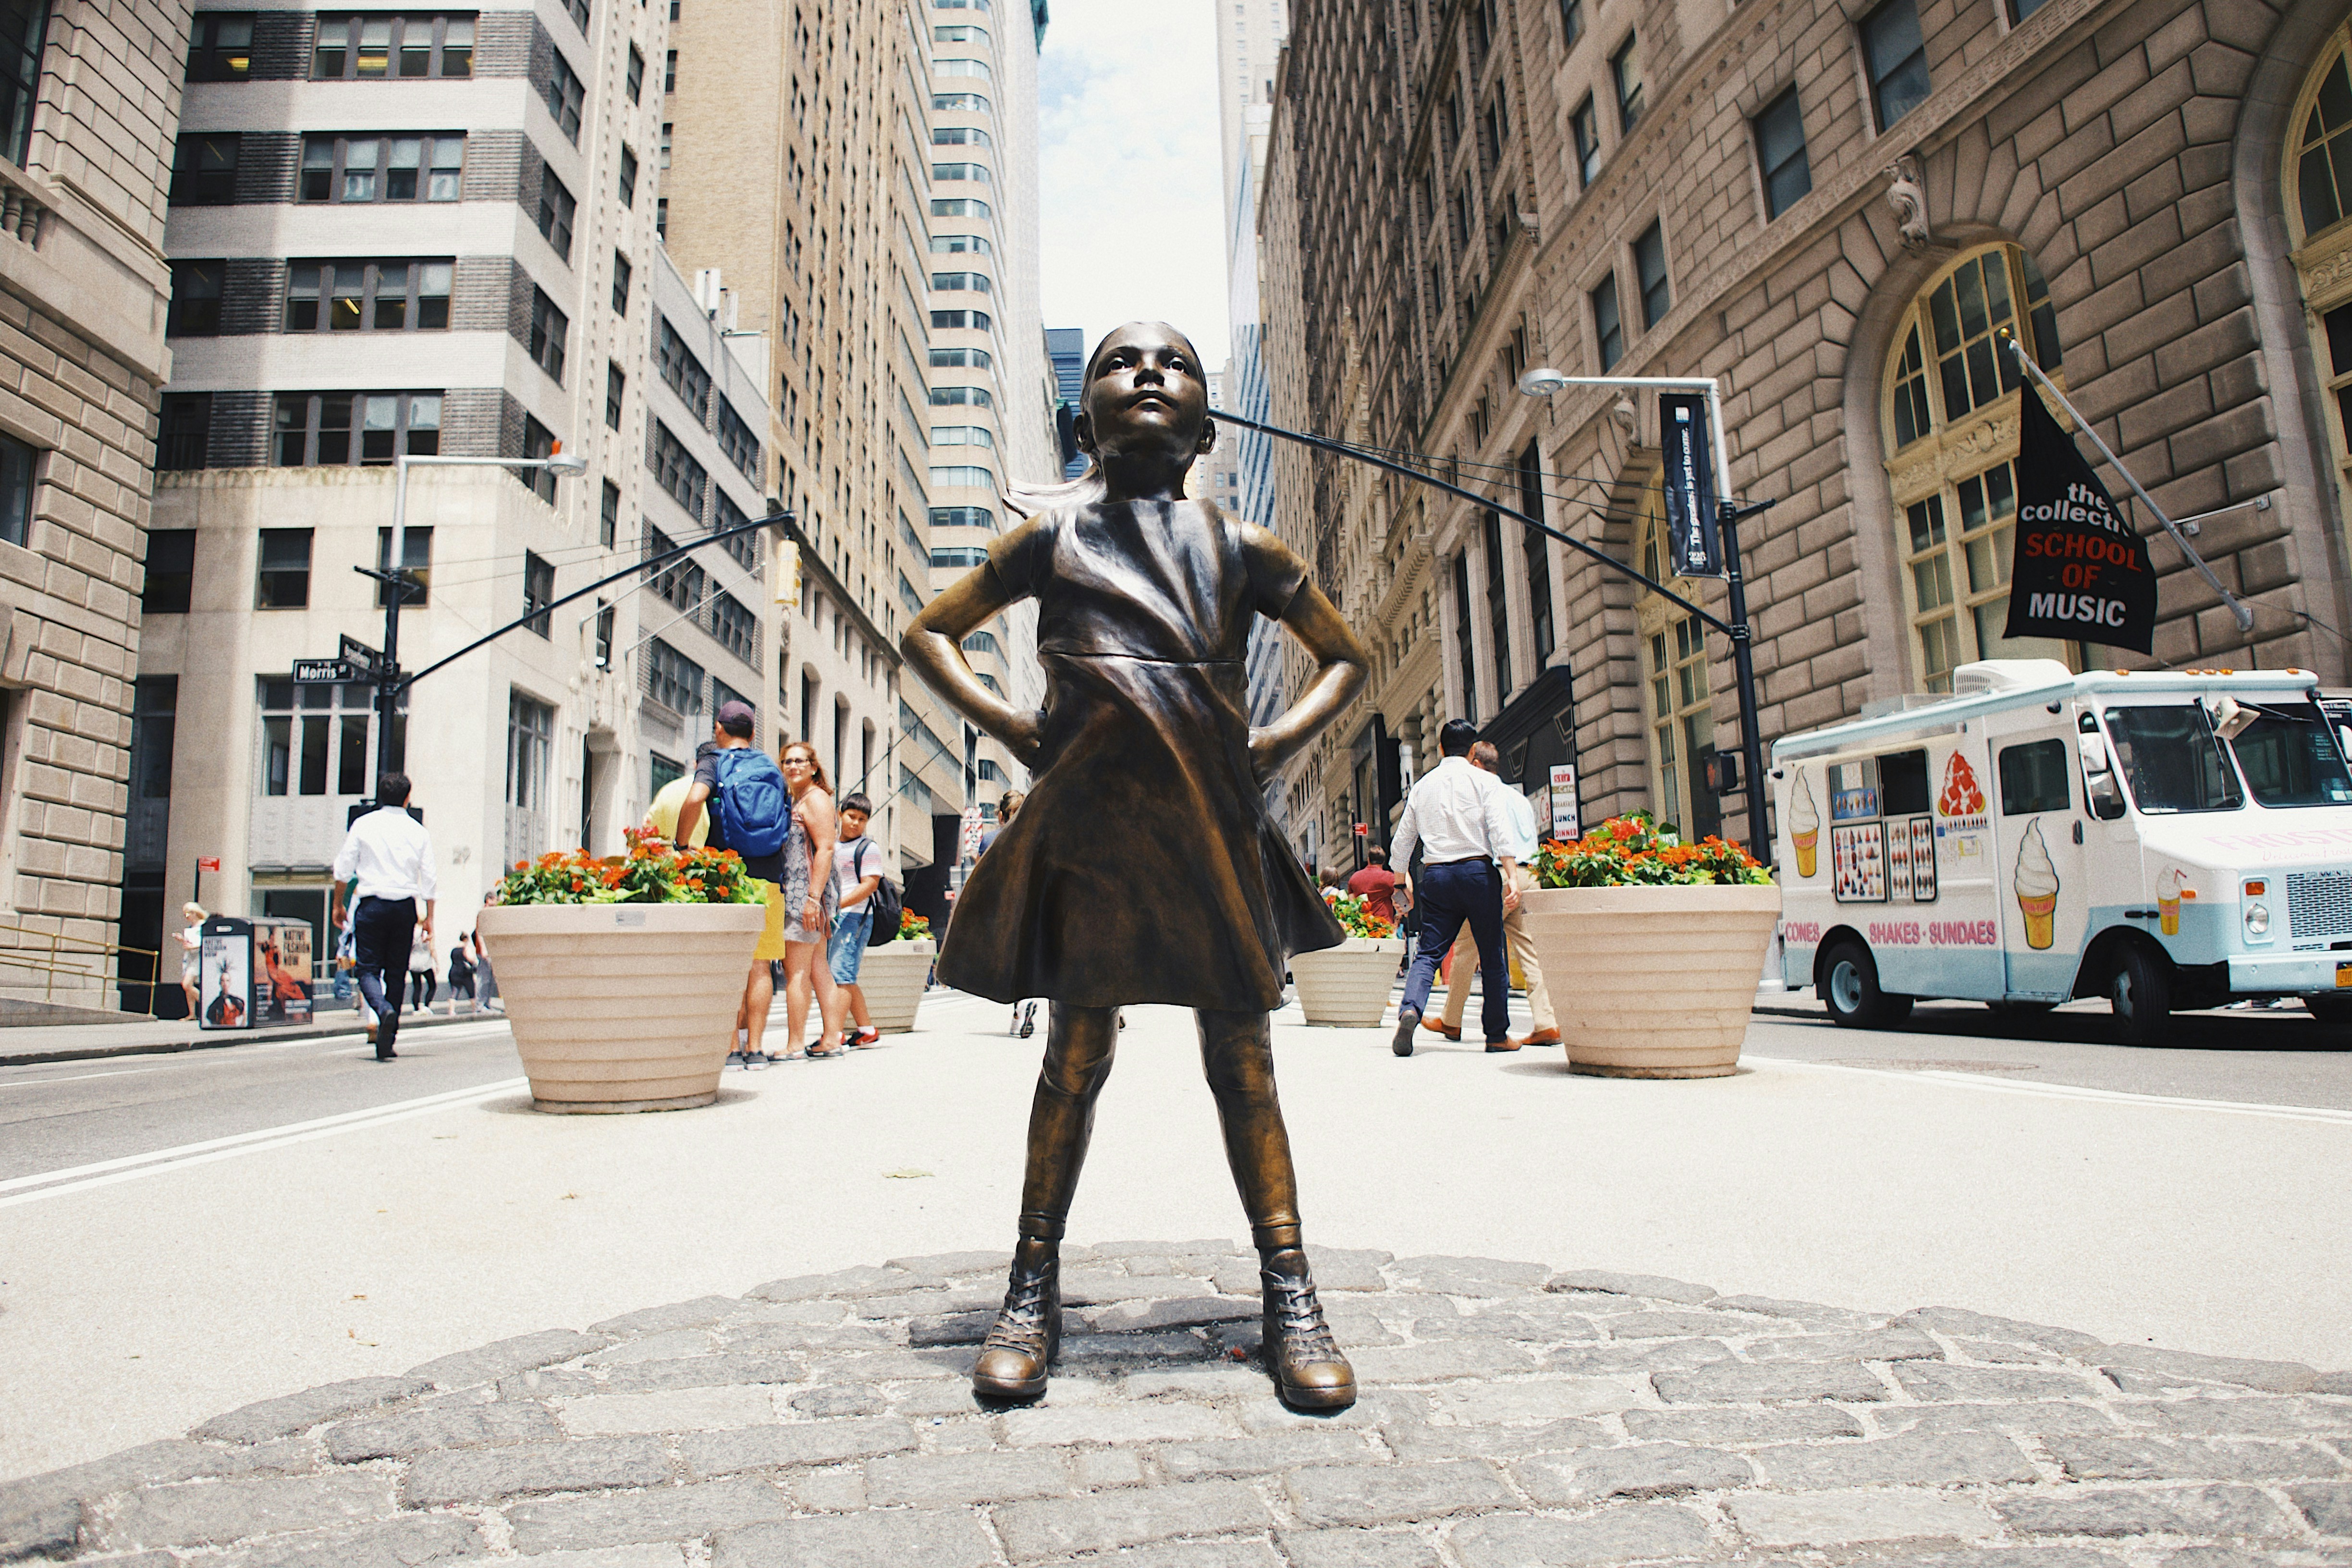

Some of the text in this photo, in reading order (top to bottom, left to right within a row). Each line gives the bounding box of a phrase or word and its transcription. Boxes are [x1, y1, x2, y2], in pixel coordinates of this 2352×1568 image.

[2068, 482, 2111, 511] the
[2025, 532, 2142, 573] SCHOOL
[2061, 563, 2102, 589] OF
[2028, 592, 2127, 627] MUSIC
[299, 665, 337, 680] Morris
[1555, 814, 1576, 822] LUNCH
[1555, 828, 1577, 837] DINNER
[1785, 919, 1997, 945] CONES SHAKES SUNDAES
